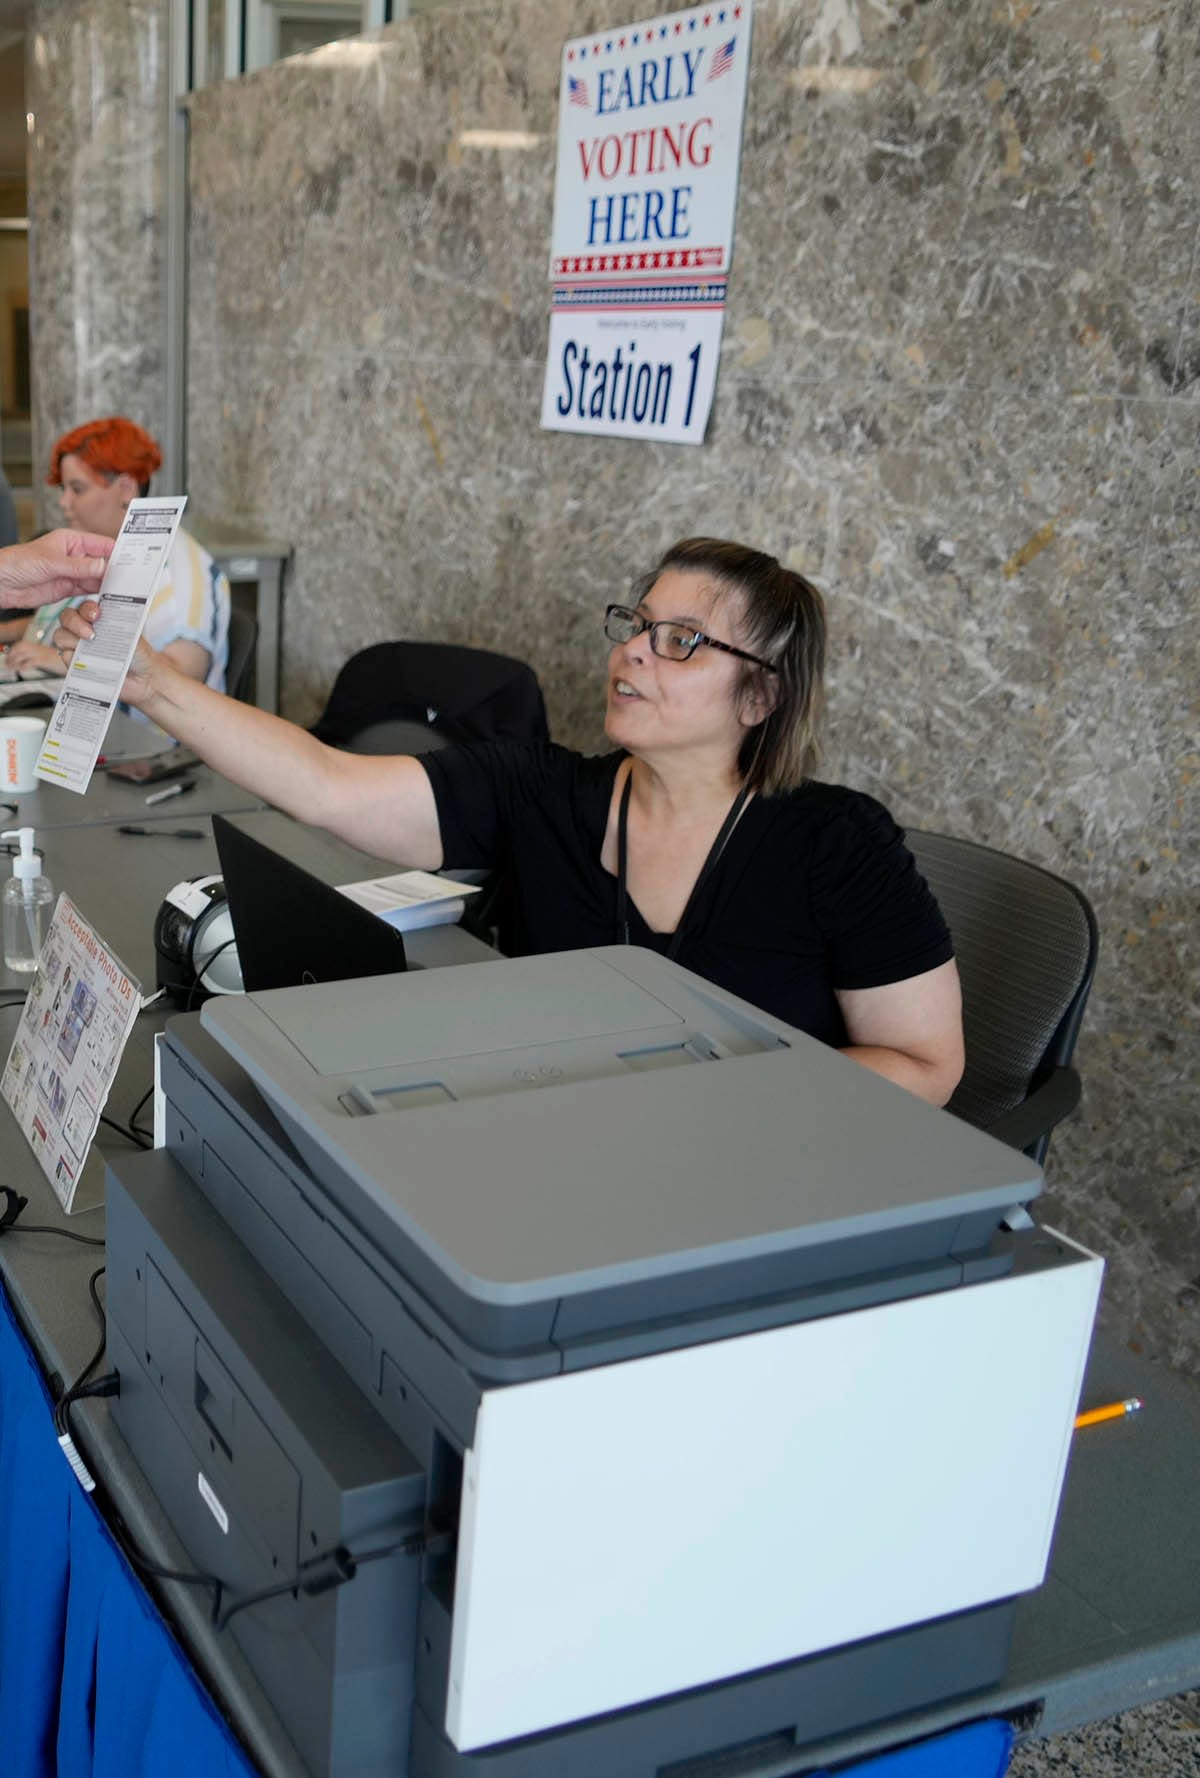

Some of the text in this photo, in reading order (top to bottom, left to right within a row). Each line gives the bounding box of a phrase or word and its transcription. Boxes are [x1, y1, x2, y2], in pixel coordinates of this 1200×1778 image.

[596, 48, 704, 115] EARLY
[577, 118, 714, 182] VOTING
[586, 185, 692, 247] HERE
[557, 339, 702, 428] Station 1
[64, 914, 99, 960] Acceptable
[97, 951, 118, 984] Photo
[117, 976, 132, 1000] IDs
